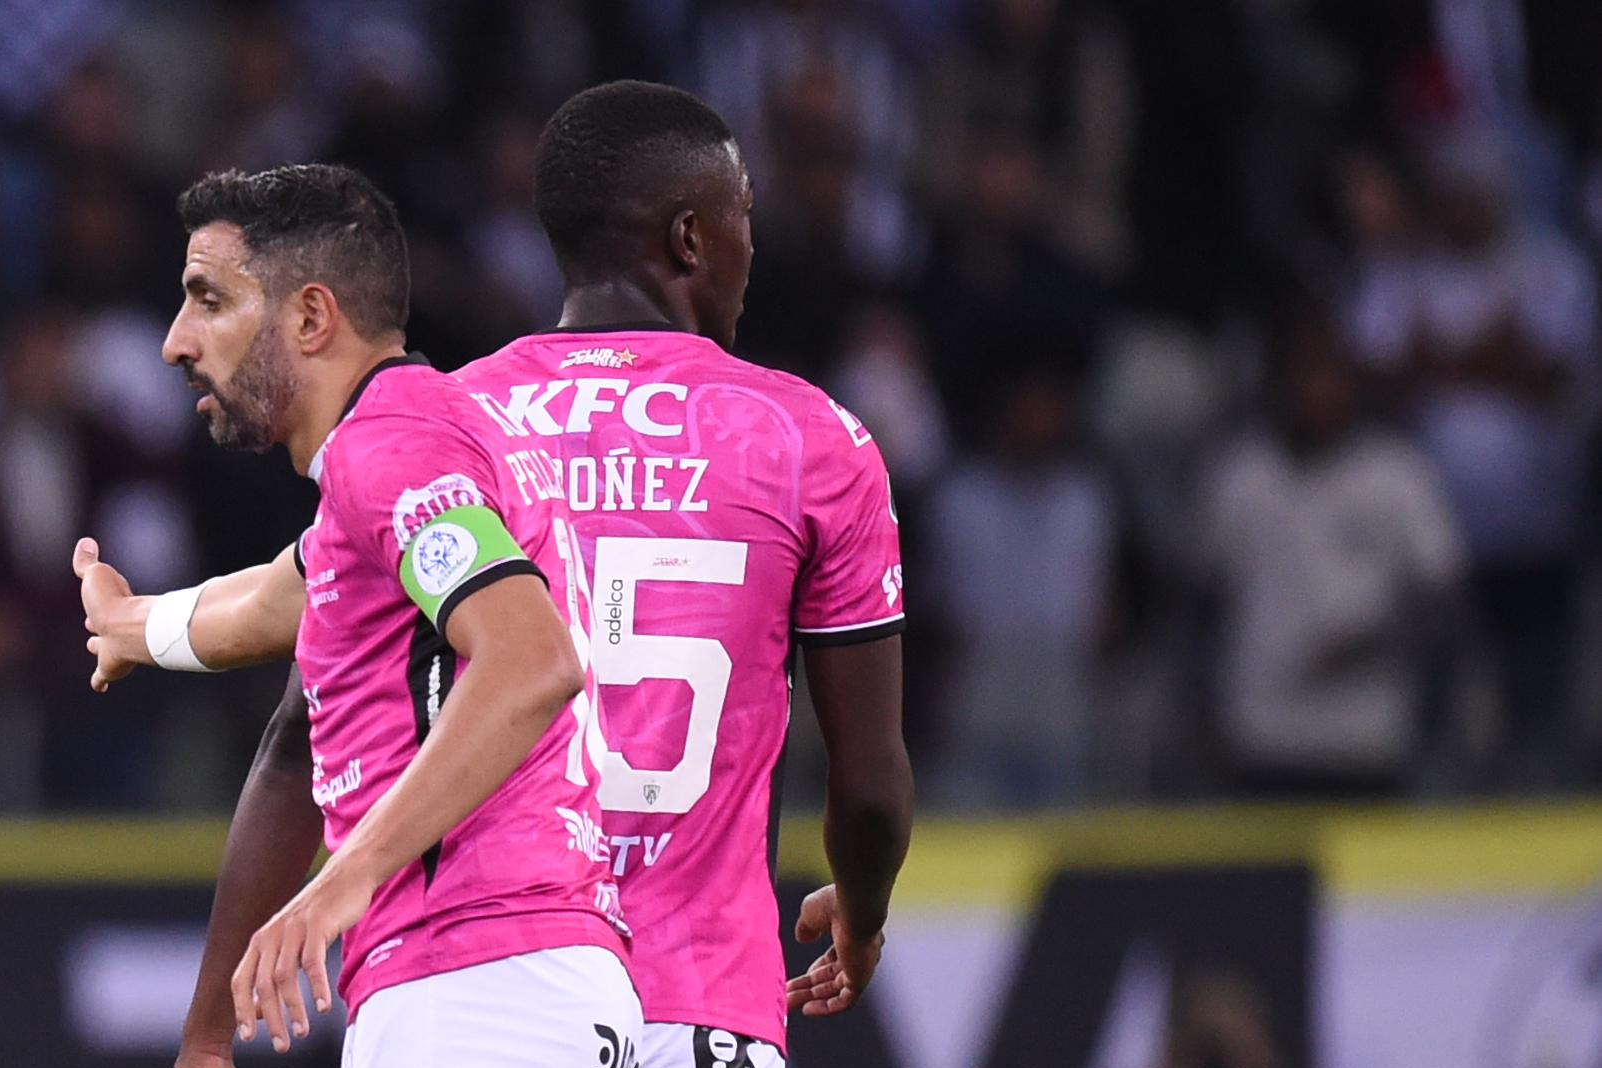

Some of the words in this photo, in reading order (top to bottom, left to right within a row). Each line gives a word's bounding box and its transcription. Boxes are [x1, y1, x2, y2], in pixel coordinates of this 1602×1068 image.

[509, 377, 689, 436] KFC
[551, 447, 710, 512] OÑEZ
[604, 579, 624, 646] adelca
